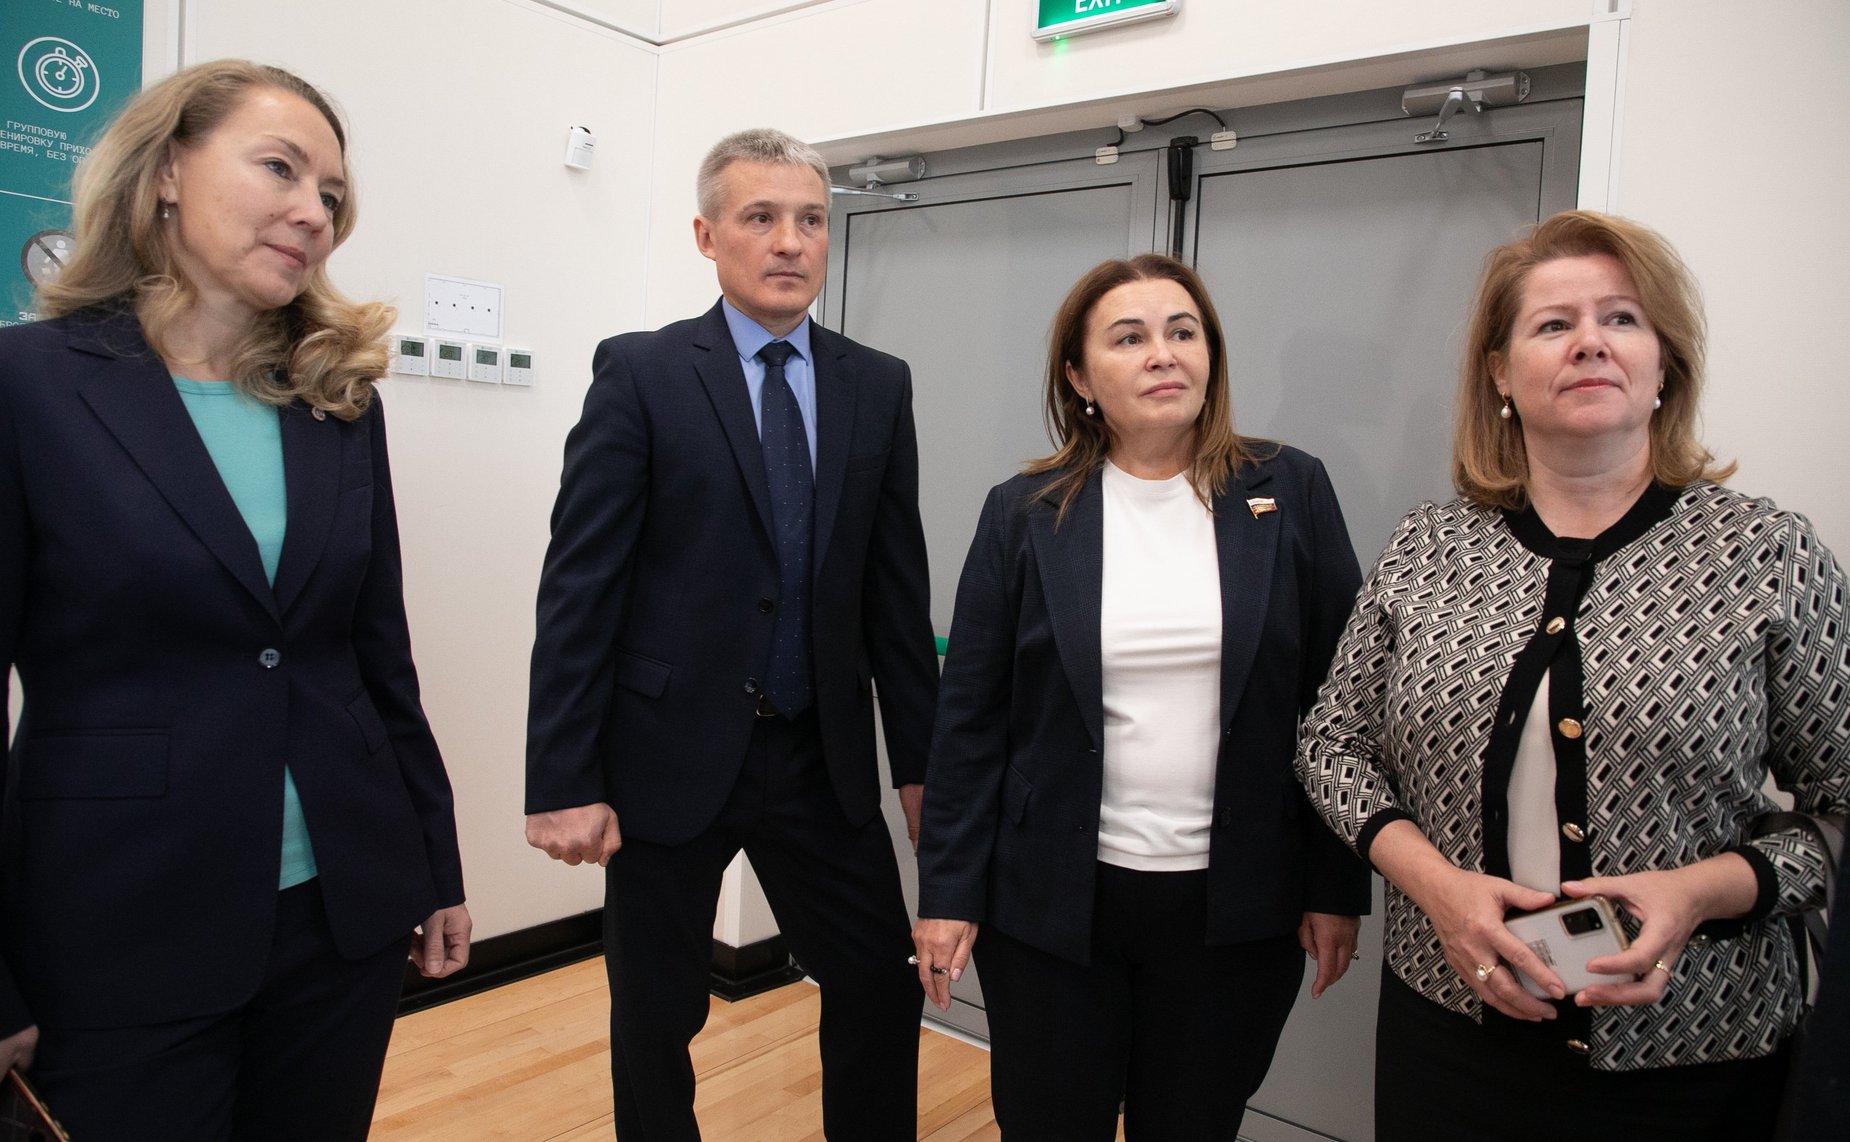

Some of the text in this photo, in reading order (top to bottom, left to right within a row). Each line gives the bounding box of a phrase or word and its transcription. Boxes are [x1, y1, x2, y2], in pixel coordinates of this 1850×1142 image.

[87, 3, 120, 19] МЕСТО
[1075, 0, 1121, 13] EX
[6, 120, 67, 141] ГРУППОВУЮ
[46, 150, 67, 161] БЕЗ
